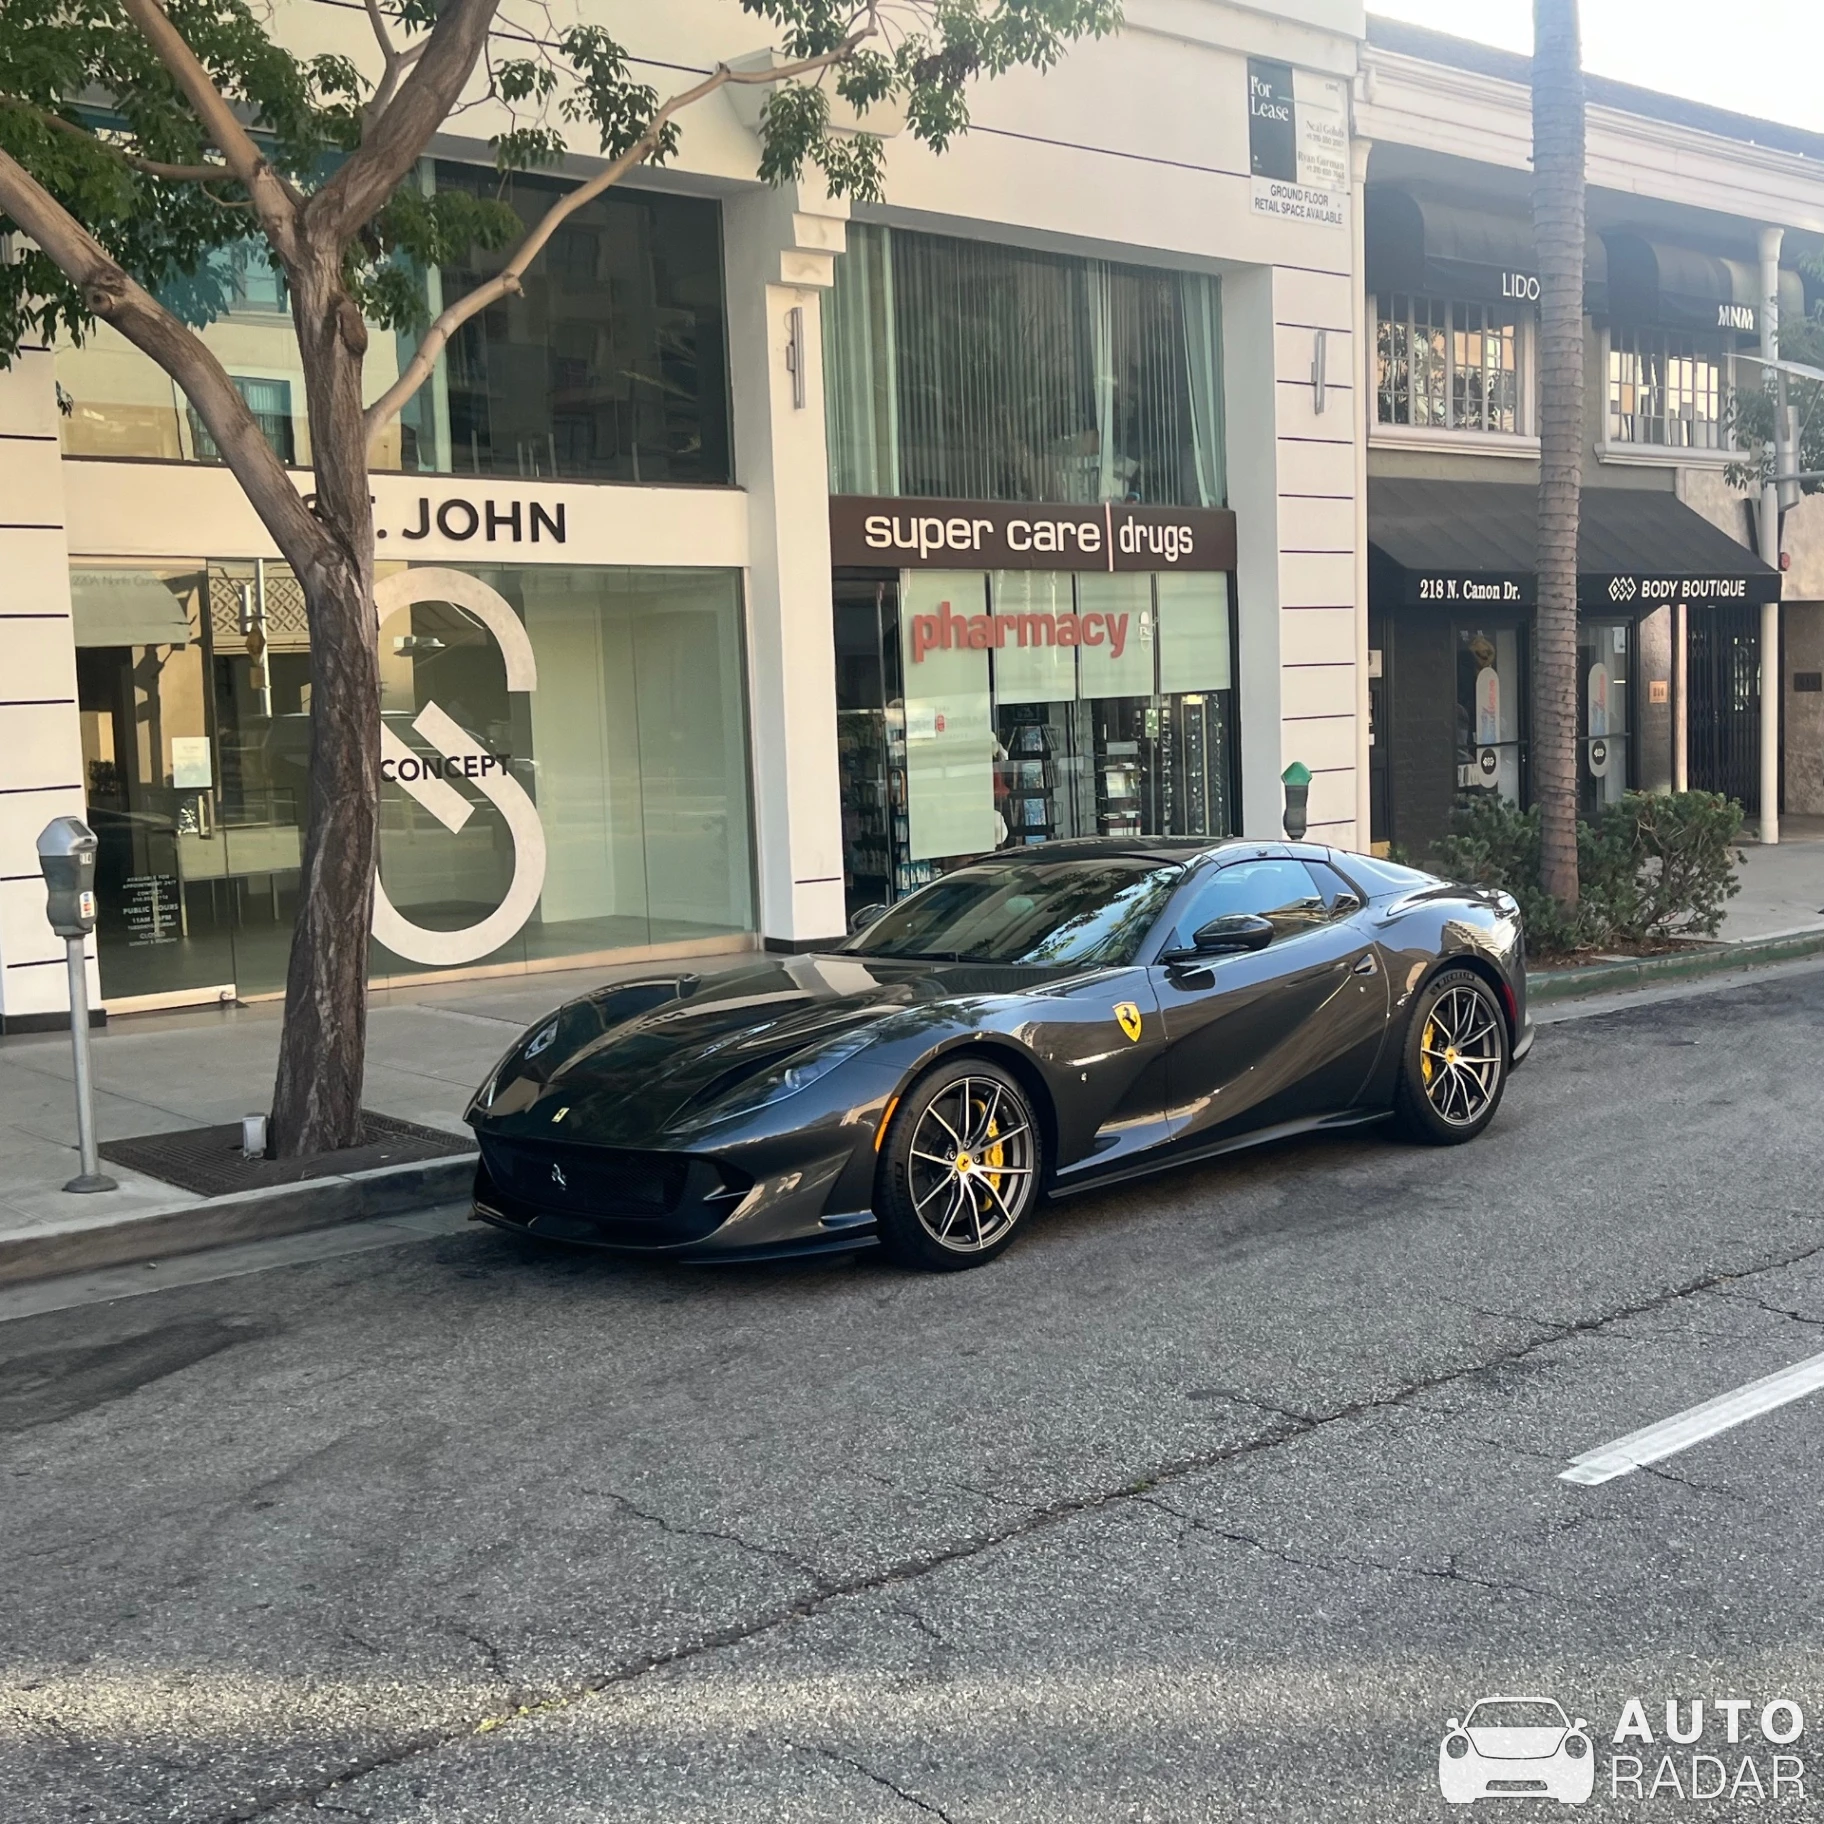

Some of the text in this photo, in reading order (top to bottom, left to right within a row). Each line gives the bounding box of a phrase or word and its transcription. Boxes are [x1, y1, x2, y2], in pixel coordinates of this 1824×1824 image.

[1250, 75, 1272, 98] For
[1250, 95, 1289, 121] Lease
[1271, 184, 1329, 207] GROUND FLOOR
[1255, 197, 1343, 225] RETAIL SPACE AVAILABLE
[1502, 272, 1540, 301] LIDO
[402, 497, 566, 543] JOHN
[865, 515, 1193, 562] super care drugs
[1420, 578, 1520, 600] 218 N. Canon Dr.
[1641, 579, 1746, 598] BODY BOUTIQUE
[912, 601, 1129, 662] pharmacy
[380, 754, 511, 782] CONCEPT
[123, 903, 179, 915] PUBLIC OURS
